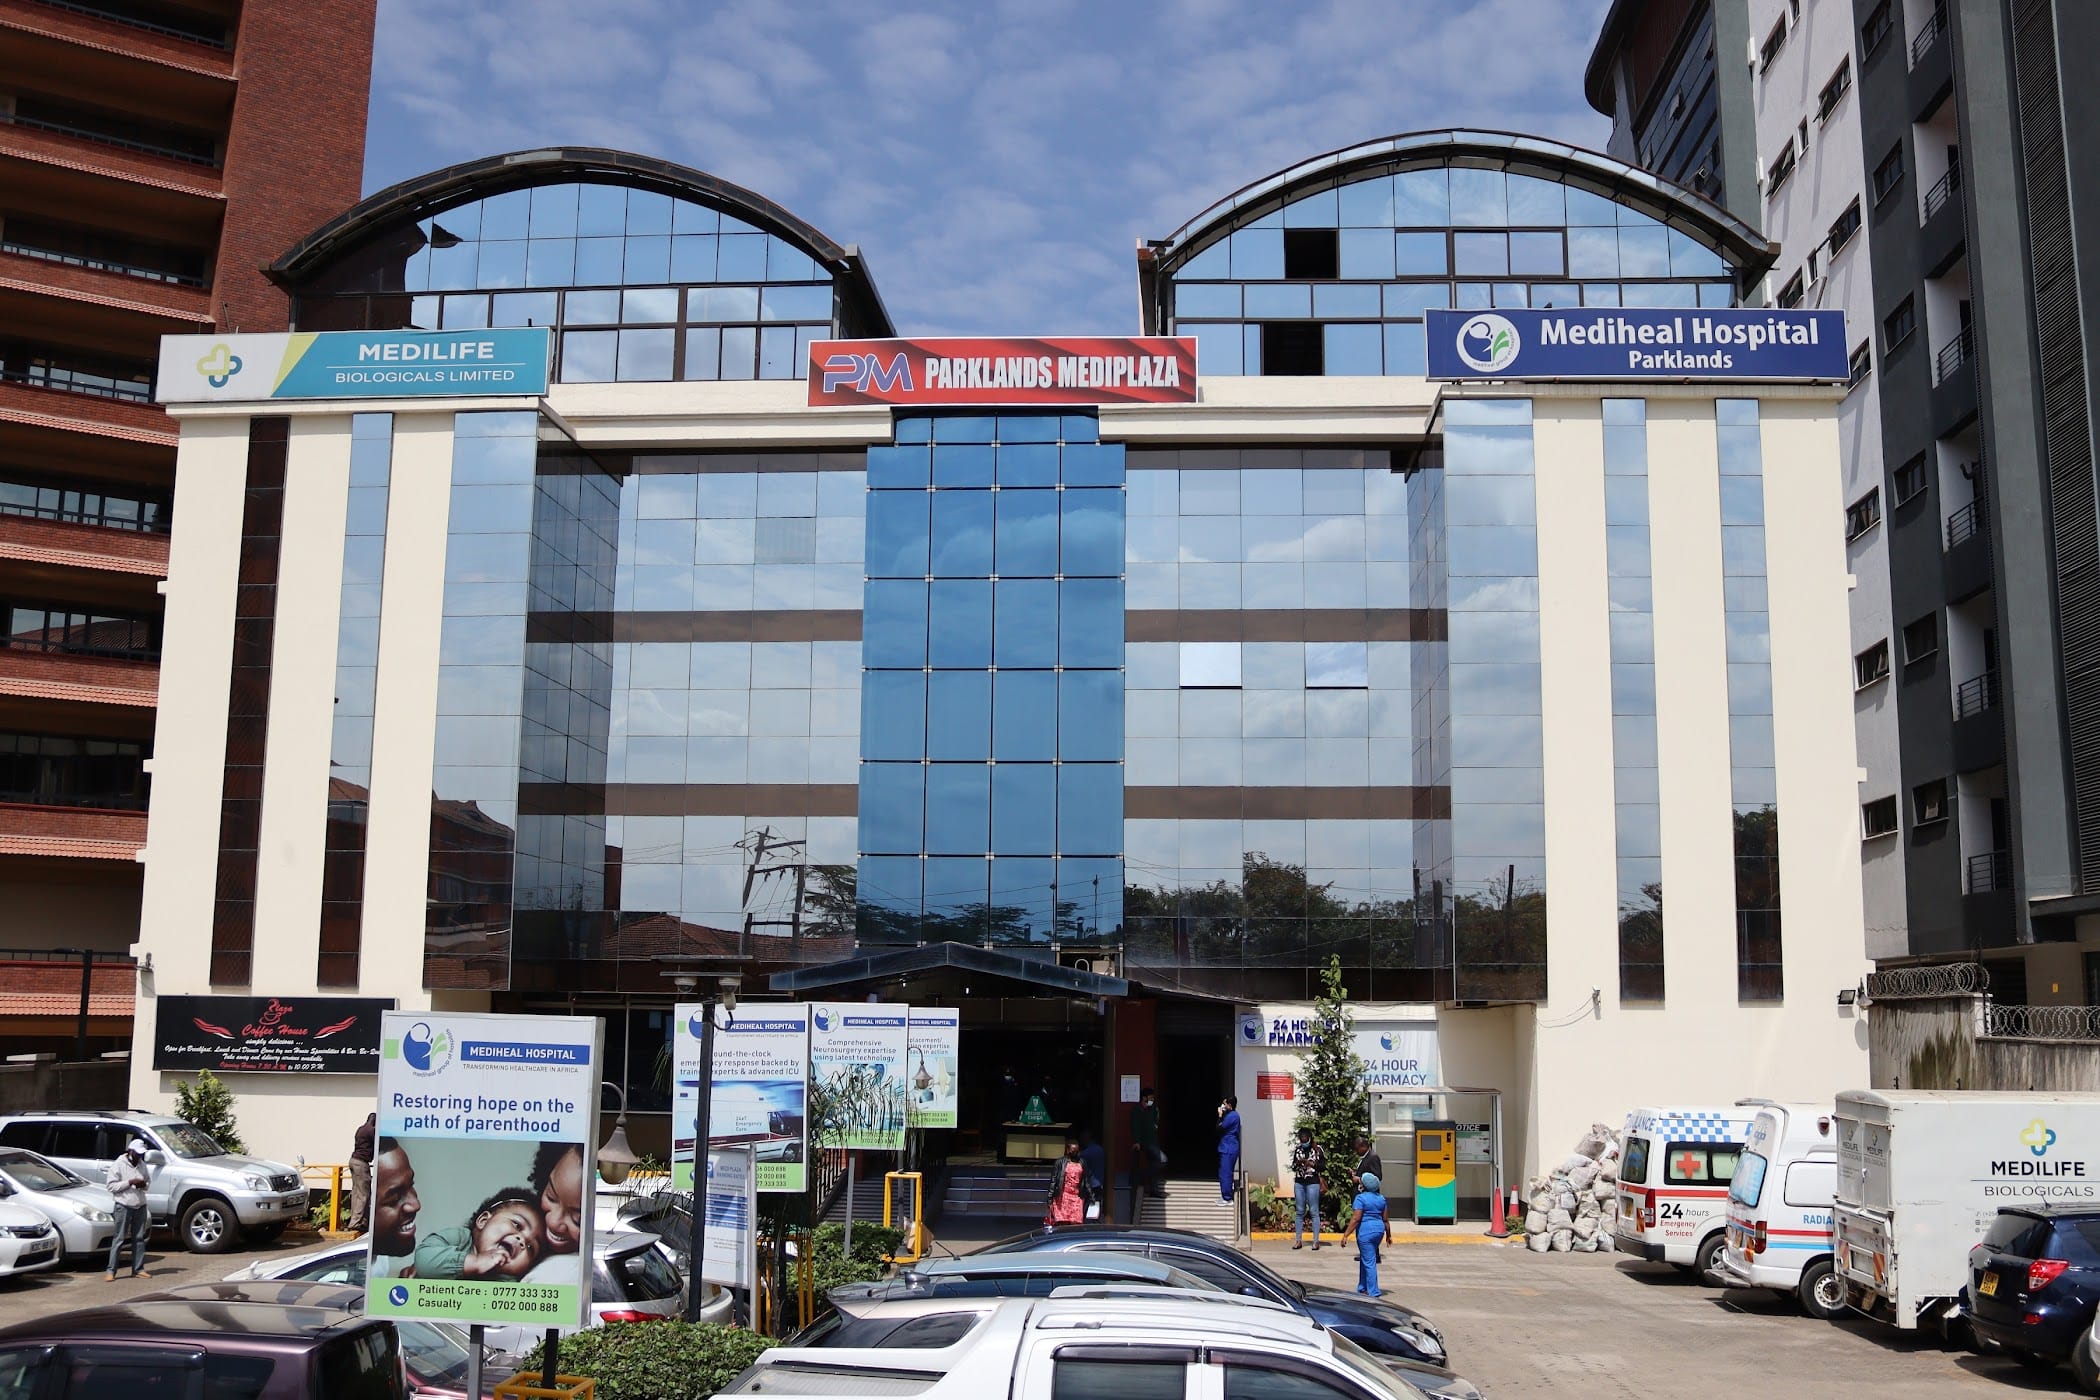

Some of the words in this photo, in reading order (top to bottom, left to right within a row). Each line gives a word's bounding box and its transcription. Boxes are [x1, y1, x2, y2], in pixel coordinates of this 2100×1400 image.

[1541, 318, 1683, 346] Mediheal
[1693, 317, 1819, 351] Hospital
[358, 341, 495, 362] MEDILIFE
[1629, 349, 1733, 369] Parklands
[335, 370, 446, 384] BIOLOGICALS
[449, 369, 515, 382] LIMITED
[823, 351, 915, 393] PM
[925, 356, 1052, 389] PARKLANDS
[1058, 355, 1180, 388] MEDIPLAZA
[241, 1023, 274, 1037] Coffee
[277, 1024, 309, 1035] House
[1273, 1019, 1288, 1031] 24
[245, 1039, 267, 1047] simply
[828, 1038, 882, 1046] Comprehensive
[1269, 1032, 1324, 1045] PHARMA
[164, 1044, 178, 1053] Open
[178, 1045, 187, 1054] for
[470, 1046, 524, 1058] MEDIHEAL
[525, 1048, 576, 1060] HOSPITAL
[813, 1046, 862, 1054] Neurosurgery
[922, 1043, 950, 1051] expertise
[261, 1054, 281, 1063] delivery
[714, 1050, 772, 1058] ound-the-clock
[856, 1054, 895, 1062] technology
[463, 1063, 508, 1072] TRANSFORMING
[509, 1064, 548, 1073] HEALTHCARE
[724, 1060, 760, 1068] response
[791, 1059, 800, 1067] by
[1363, 1059, 1378, 1071] 24
[1381, 1059, 1418, 1071] HOUR
[713, 1068, 738, 1076] xperts
[748, 1067, 784, 1075] advanced
[393, 1093, 472, 1113] Restoring
[477, 1096, 518, 1115] hope
[522, 1100, 542, 1112] on
[548, 1098, 575, 1113] the
[404, 1115, 440, 1132] path
[444, 1115, 461, 1129] of
[465, 1117, 560, 1133] parenthood
[1991, 1160, 2086, 1177] MEDILIFE
[1984, 1185, 2094, 1197] BIOLOGICALS
[1660, 1203, 1684, 1219] 24
[1686, 1207, 1710, 1217] hours
[1660, 1219, 1696, 1230] Emergency
[1803, 1214, 1835, 1225] RADIA
[1665, 1229, 1693, 1237] Services
[419, 1284, 456, 1296] Patient
[457, 1285, 481, 1296] Care
[492, 1287, 517, 1298] 0777
[519, 1288, 538, 1298] 333
[541, 1288, 560, 1299] 333
[418, 1297, 462, 1311] Casualty
[491, 1301, 516, 1311] 0702
[518, 1302, 537, 1312] 000
[539, 1302, 558, 1313] 888
